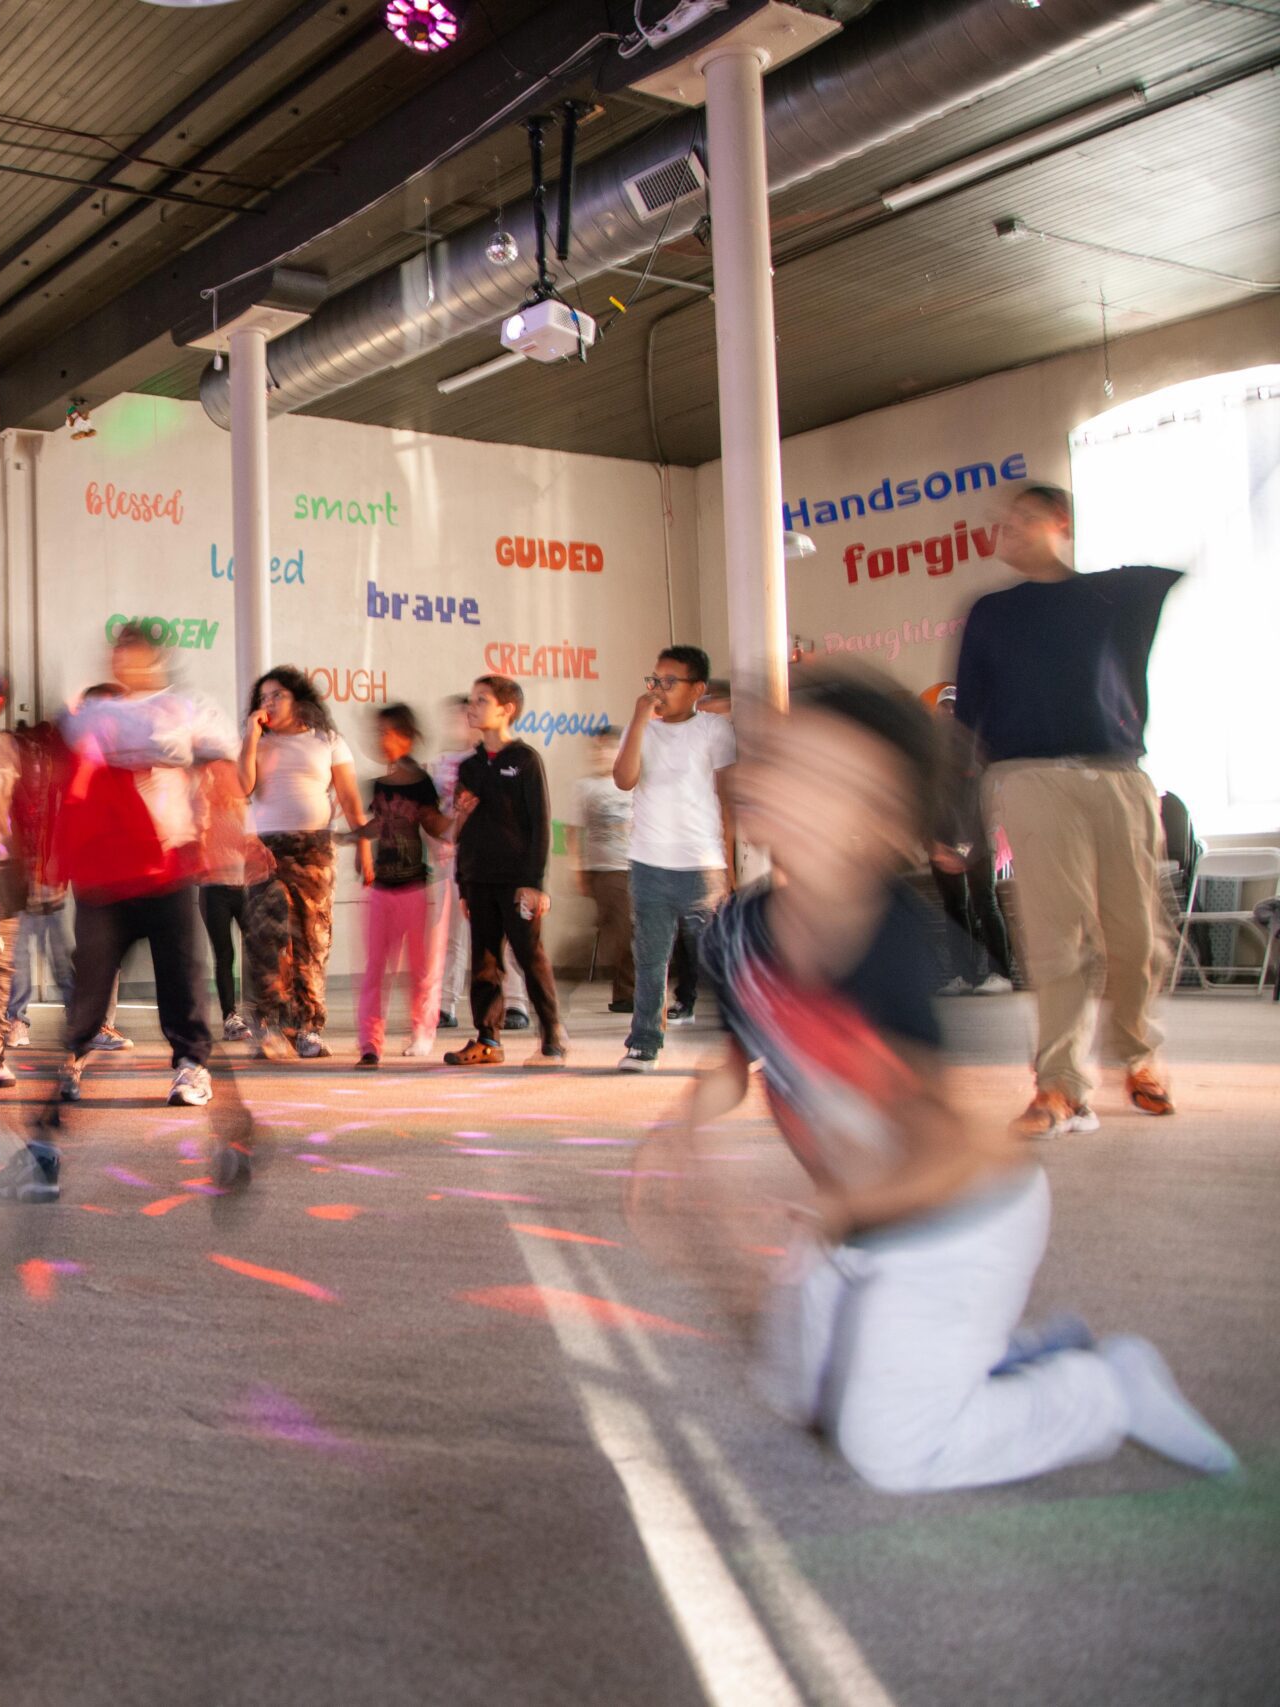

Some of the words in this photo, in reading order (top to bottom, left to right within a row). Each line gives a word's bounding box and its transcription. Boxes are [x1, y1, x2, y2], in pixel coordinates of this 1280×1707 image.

[85, 481, 184, 525] blessed
[294, 491, 398, 526] smart
[783, 453, 1027, 531] Handsome
[210, 543, 305, 584] led
[495, 535, 604, 573] GUIDED
[842, 520, 1001, 585] forgiv
[367, 580, 480, 625] brave
[484, 639, 599, 680] CREATIVE
[304, 667, 387, 704] OUGH
[514, 710, 611, 746] ageous
